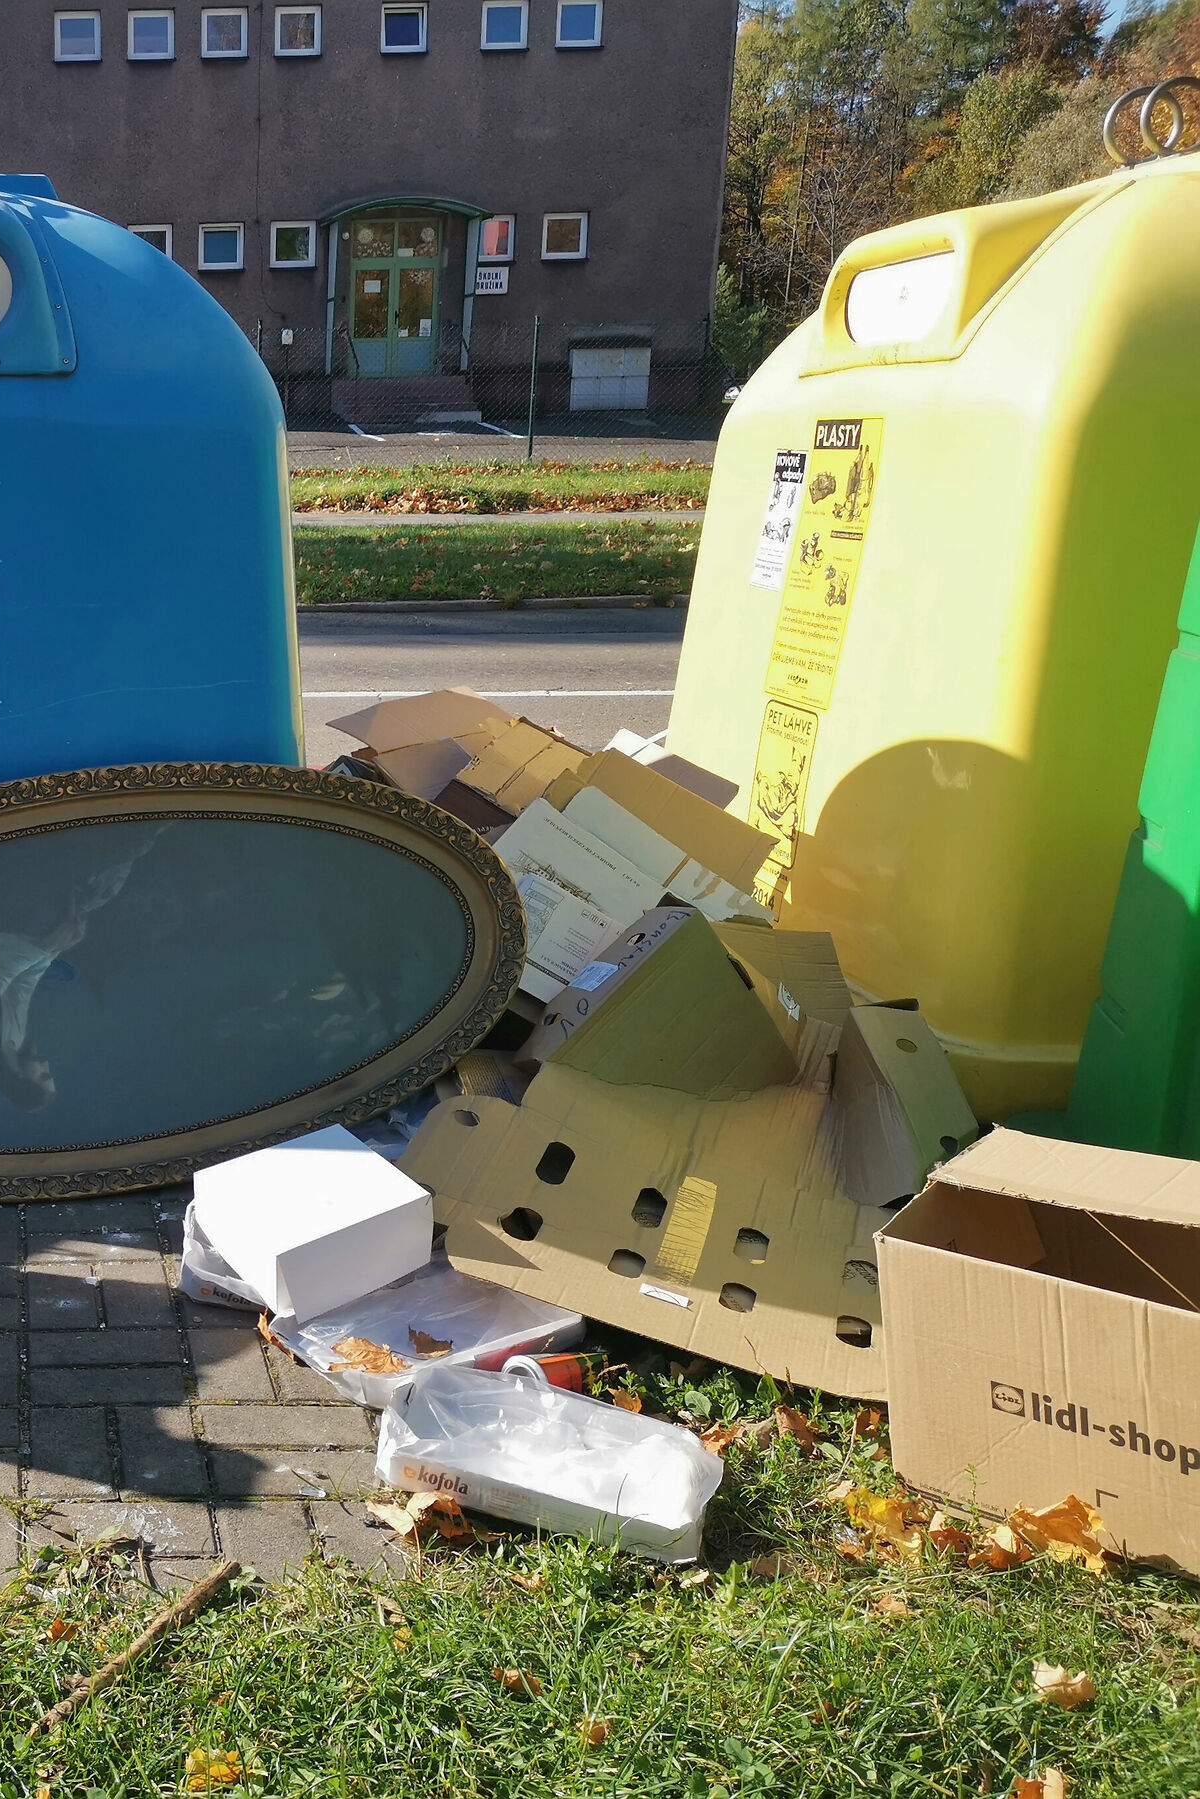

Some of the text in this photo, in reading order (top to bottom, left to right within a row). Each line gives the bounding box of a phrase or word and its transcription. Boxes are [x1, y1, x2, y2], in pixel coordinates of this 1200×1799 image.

[815, 424, 861, 447] PLASTY
[781, 467, 804, 482] odpady
[768, 709, 813, 737] PET LÁHVE
[752, 886, 775, 910] 2014
[417, 1464, 469, 1496] kofola
